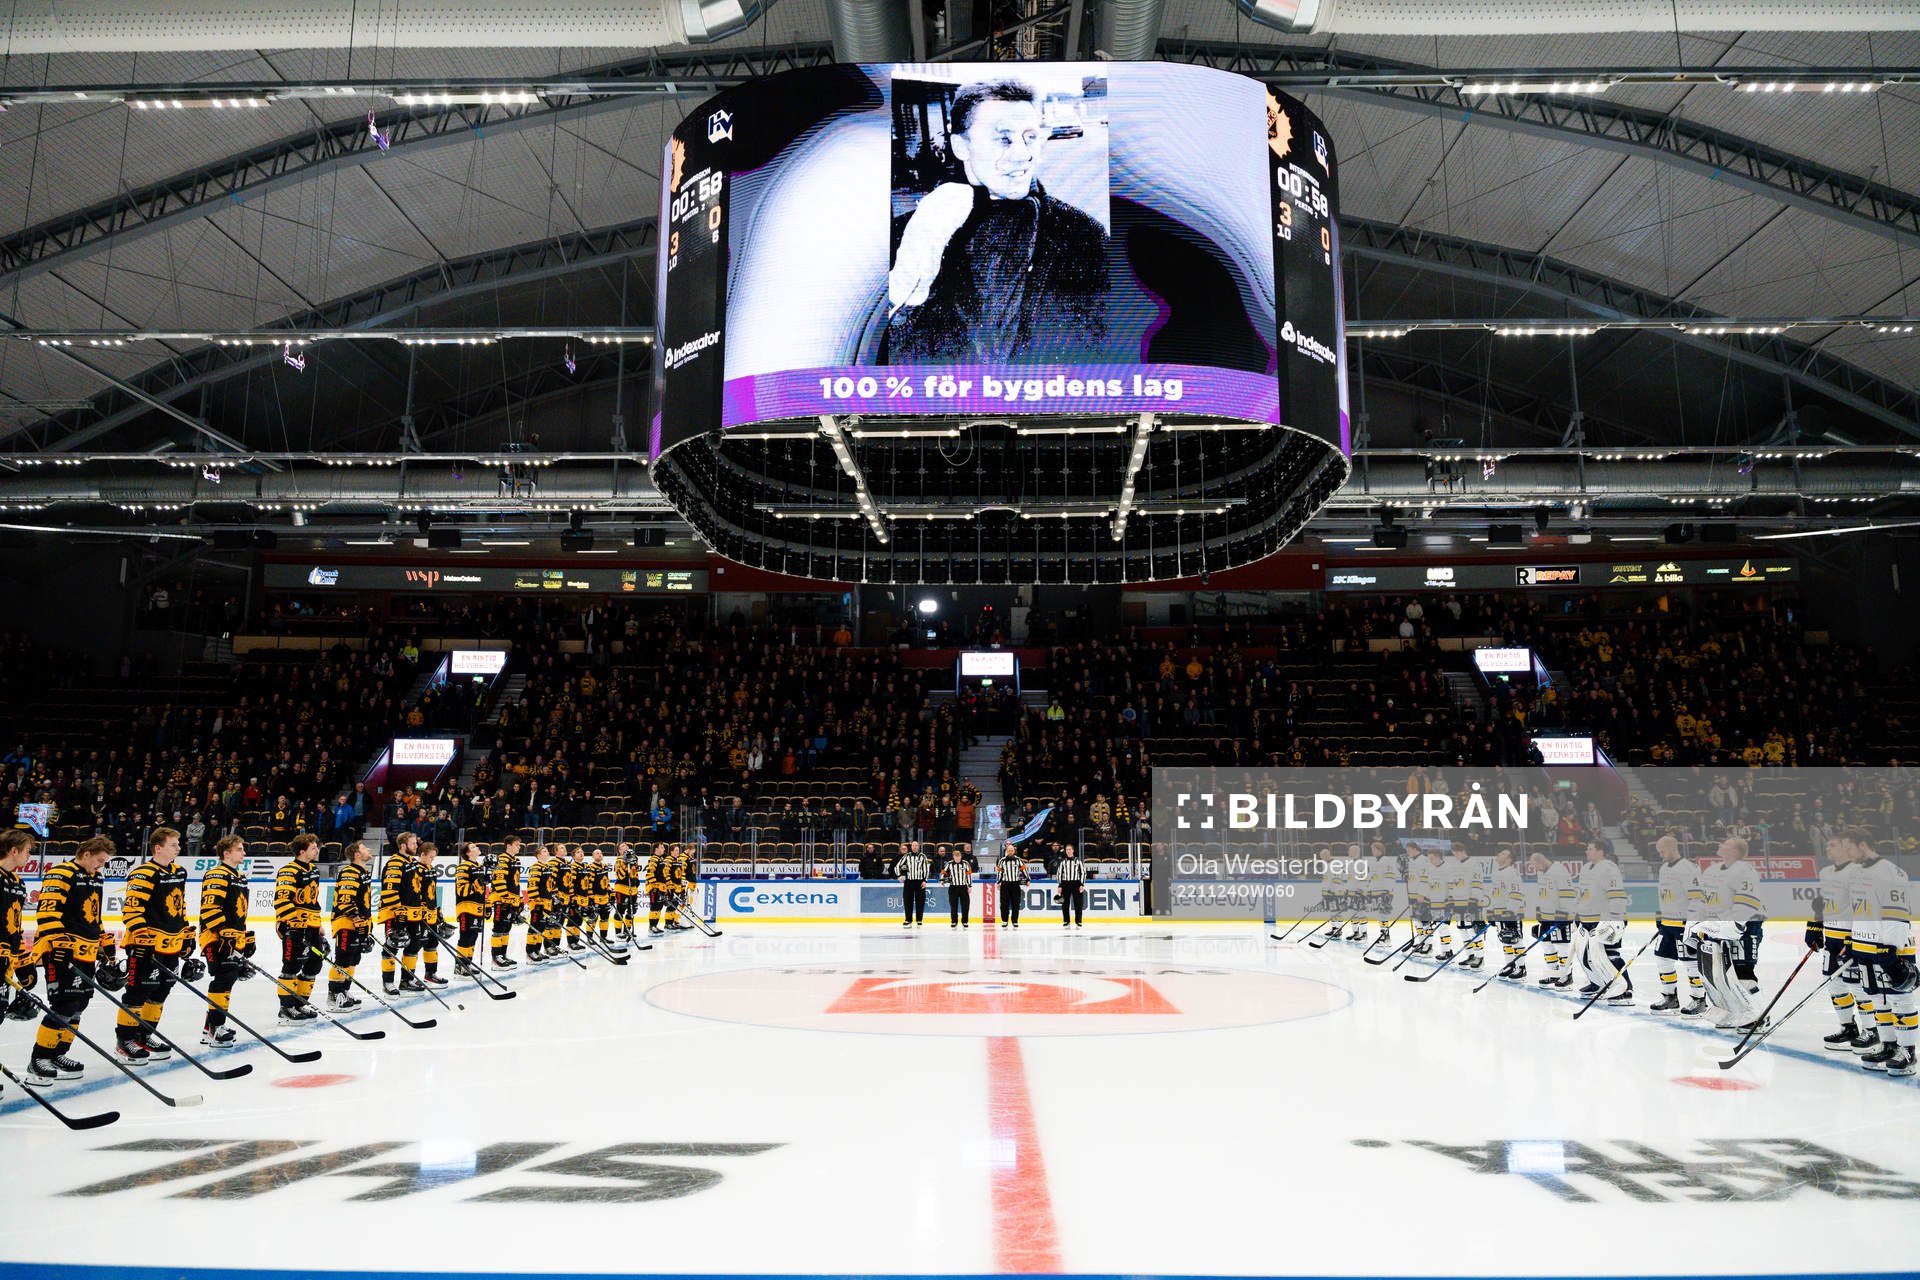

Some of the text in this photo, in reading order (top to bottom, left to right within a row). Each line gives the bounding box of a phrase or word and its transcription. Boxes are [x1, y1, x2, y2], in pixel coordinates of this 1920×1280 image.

[709, 205, 722, 231] 0
[1279, 201, 1292, 227] 3
[1276, 223, 1292, 241] 10
[1321, 226, 1330, 252] 0
[670, 231, 680, 256] 3
[668, 255, 678, 273] 10
[819, 374, 1184, 401] 100 % för bygdens lag
[1536, 570, 1576, 581] REPAY
[108, 860, 128, 869] VILDA
[202, 895, 216, 905] 18
[276, 890, 291, 900] 52
[339, 894, 352, 903] 45
[756, 891, 839, 905] extena
[886, 897, 937, 909] BJURS
[985, 884, 993, 916] CCM
[38, 900, 57, 912] 22
